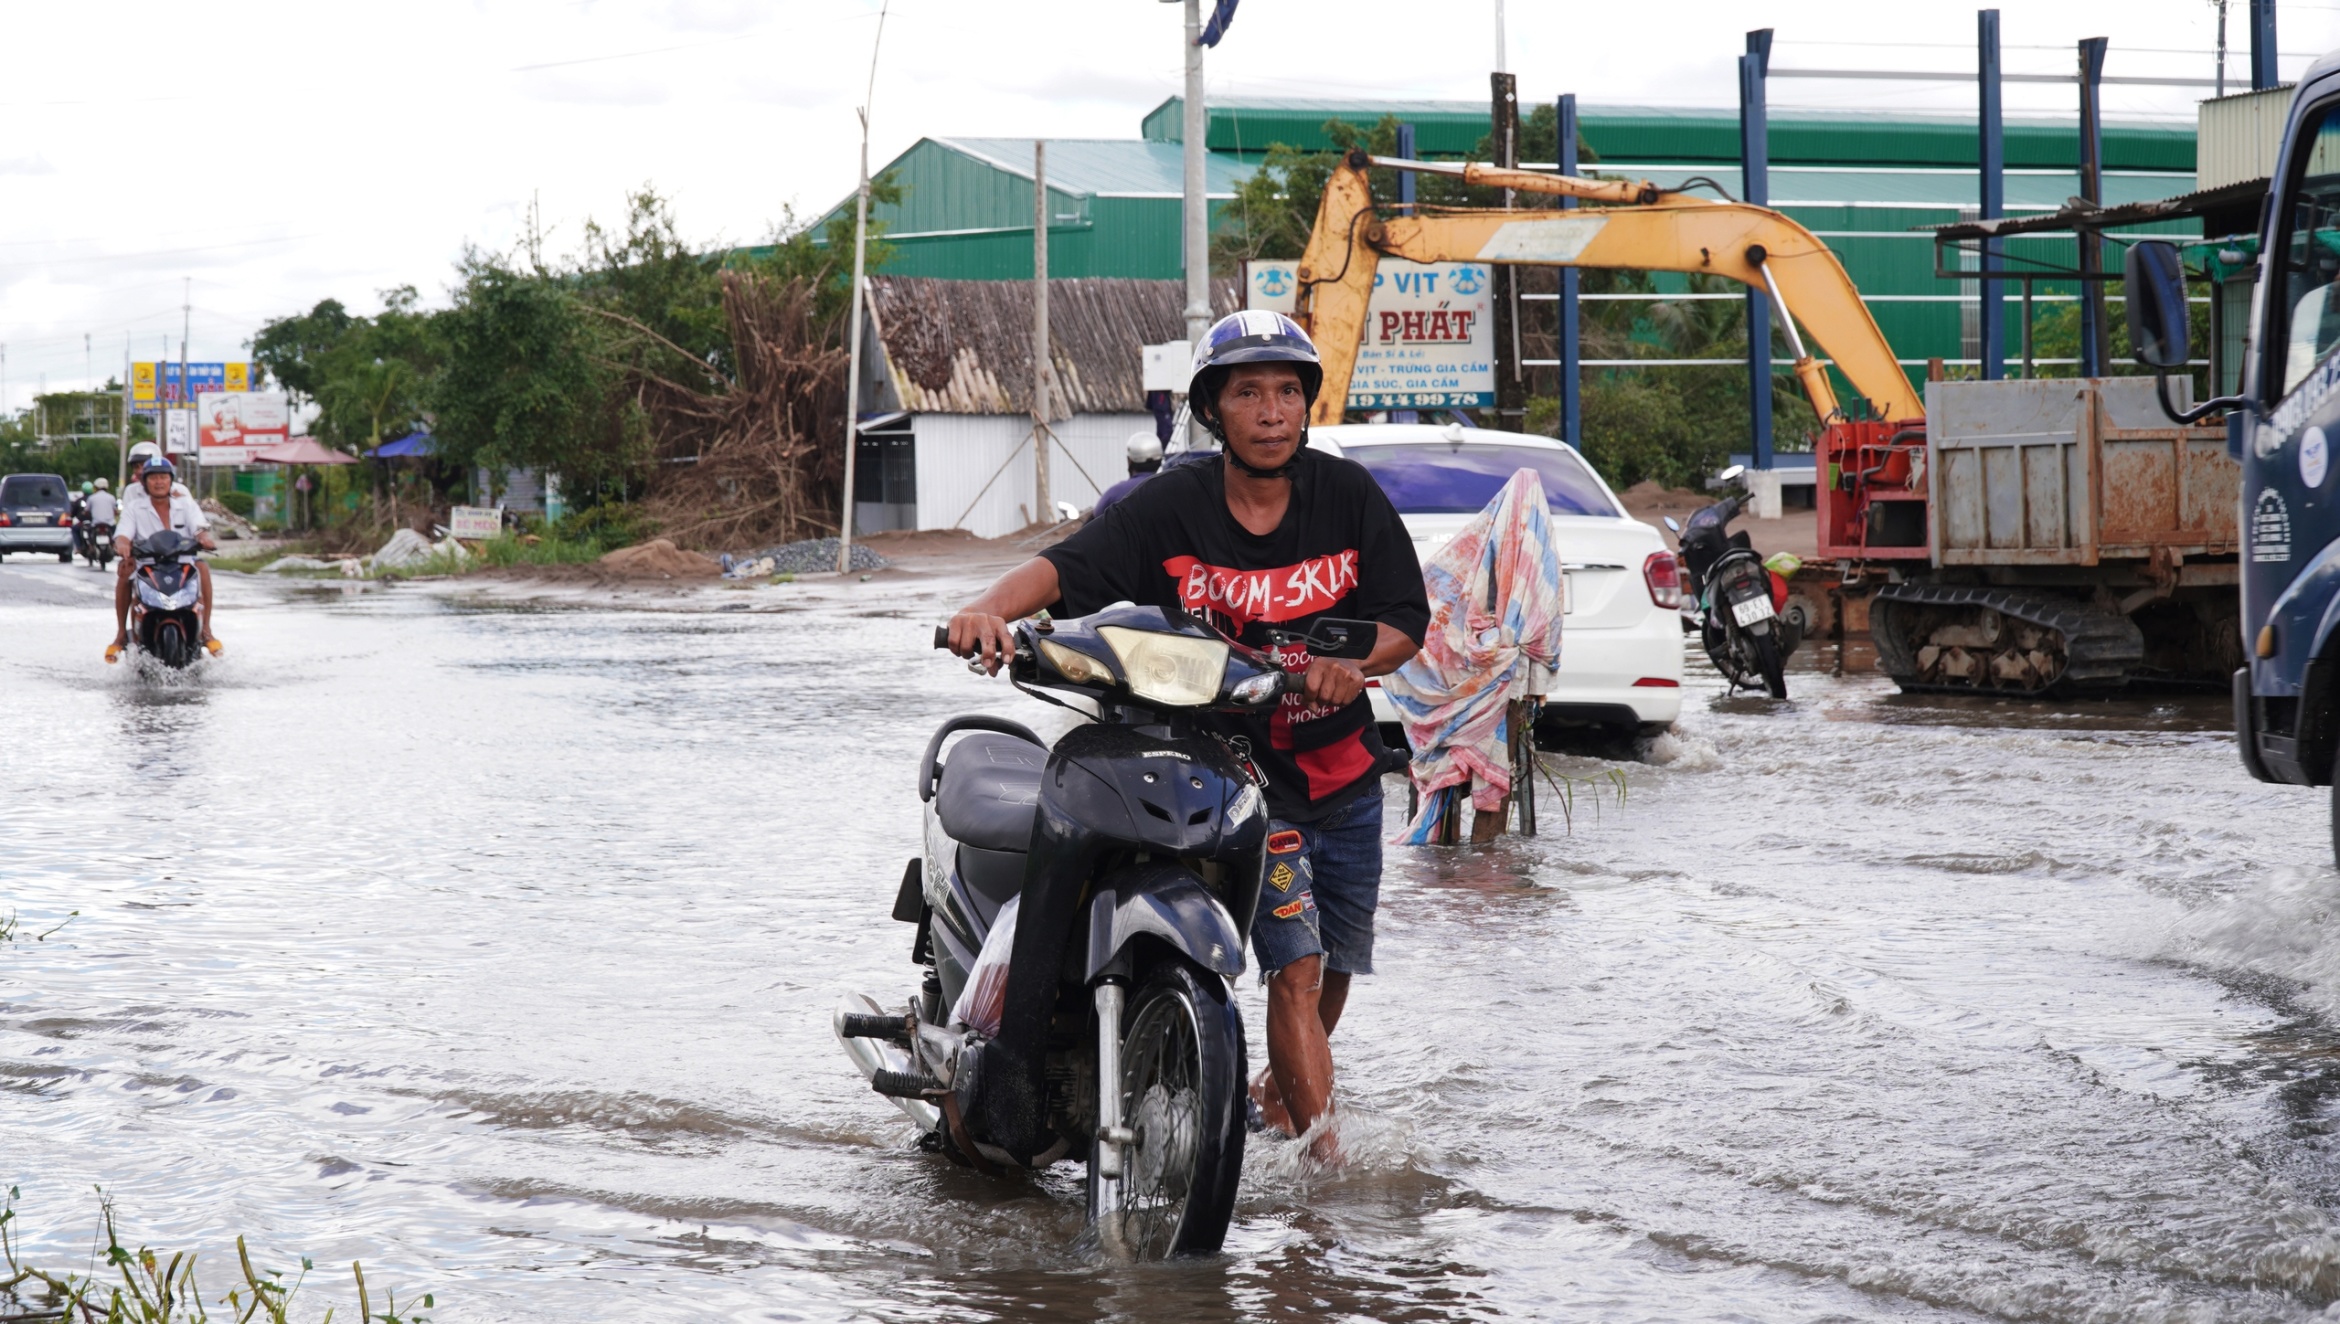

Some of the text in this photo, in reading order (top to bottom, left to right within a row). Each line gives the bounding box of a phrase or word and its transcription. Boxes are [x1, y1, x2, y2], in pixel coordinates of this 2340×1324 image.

[1393, 272, 1440, 298] VỊT
[1356, 365, 1378, 376] VỊT
[1435, 364, 1458, 374] GIA
[1349, 380, 1370, 390] GIA
[1406, 379, 1428, 389] GIA
[1380, 394, 1411, 407] 44
[1414, 393, 1446, 407] 99
[1449, 393, 1480, 406] 78
[1141, 751, 1192, 761] ESPERO
